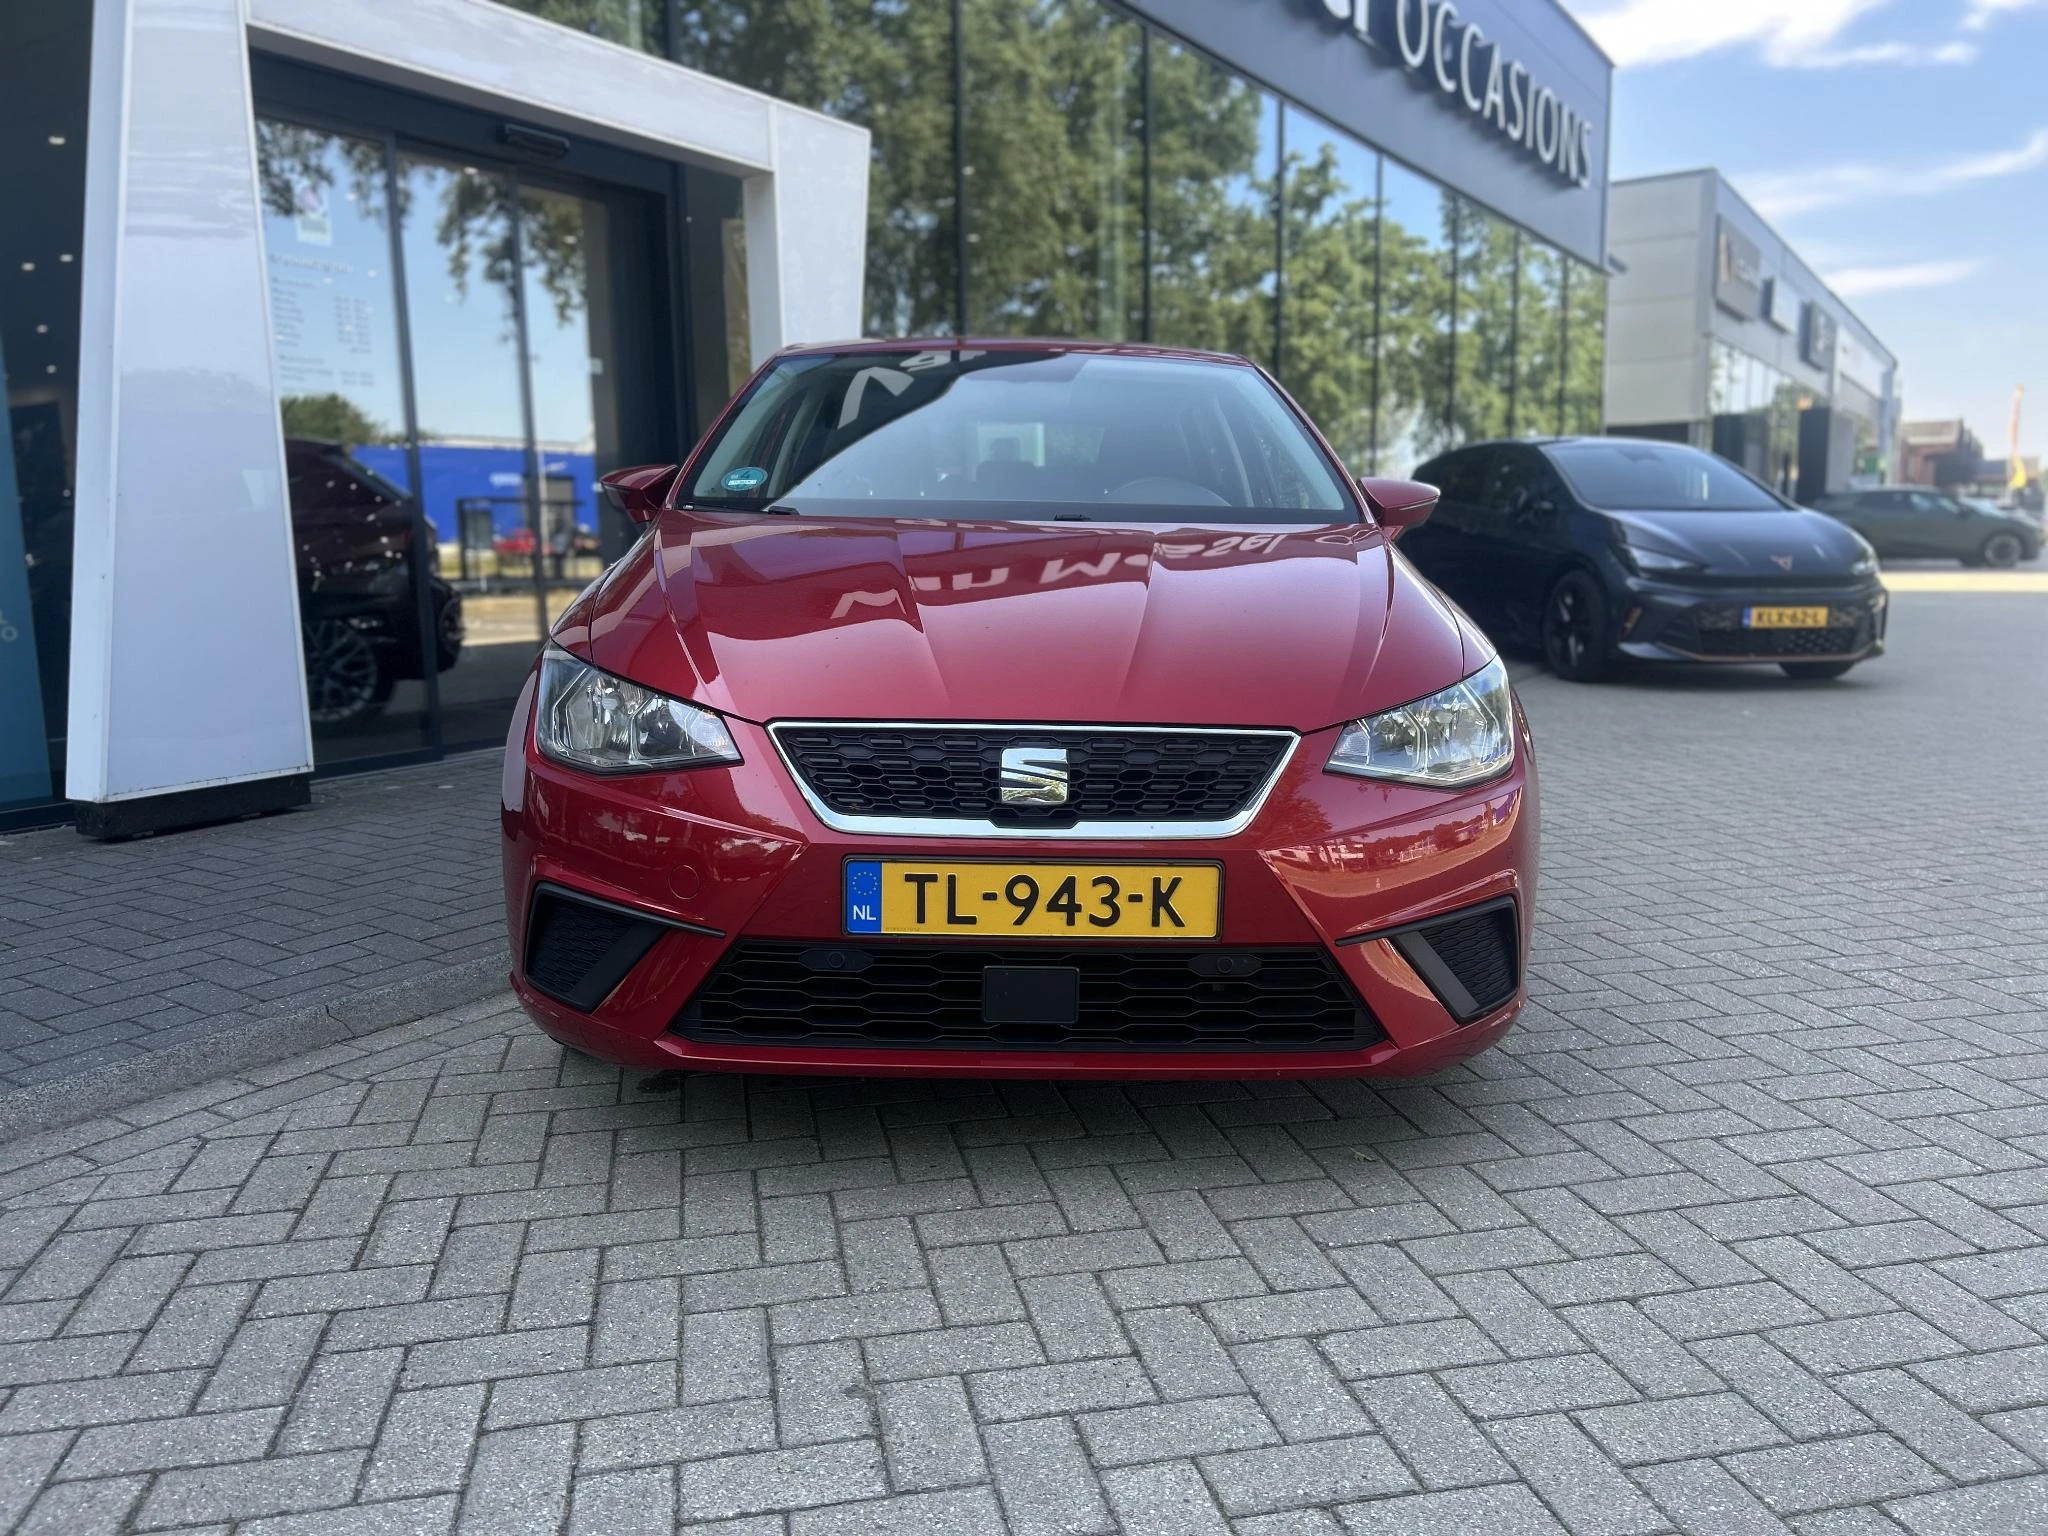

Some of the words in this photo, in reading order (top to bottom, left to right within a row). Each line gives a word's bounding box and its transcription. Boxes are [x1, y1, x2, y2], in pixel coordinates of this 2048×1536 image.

[1396, 0, 1593, 190] OCCASIONS
[852, 905, 877, 921] NL
[904, 872, 1186, 928] TL-943-K
